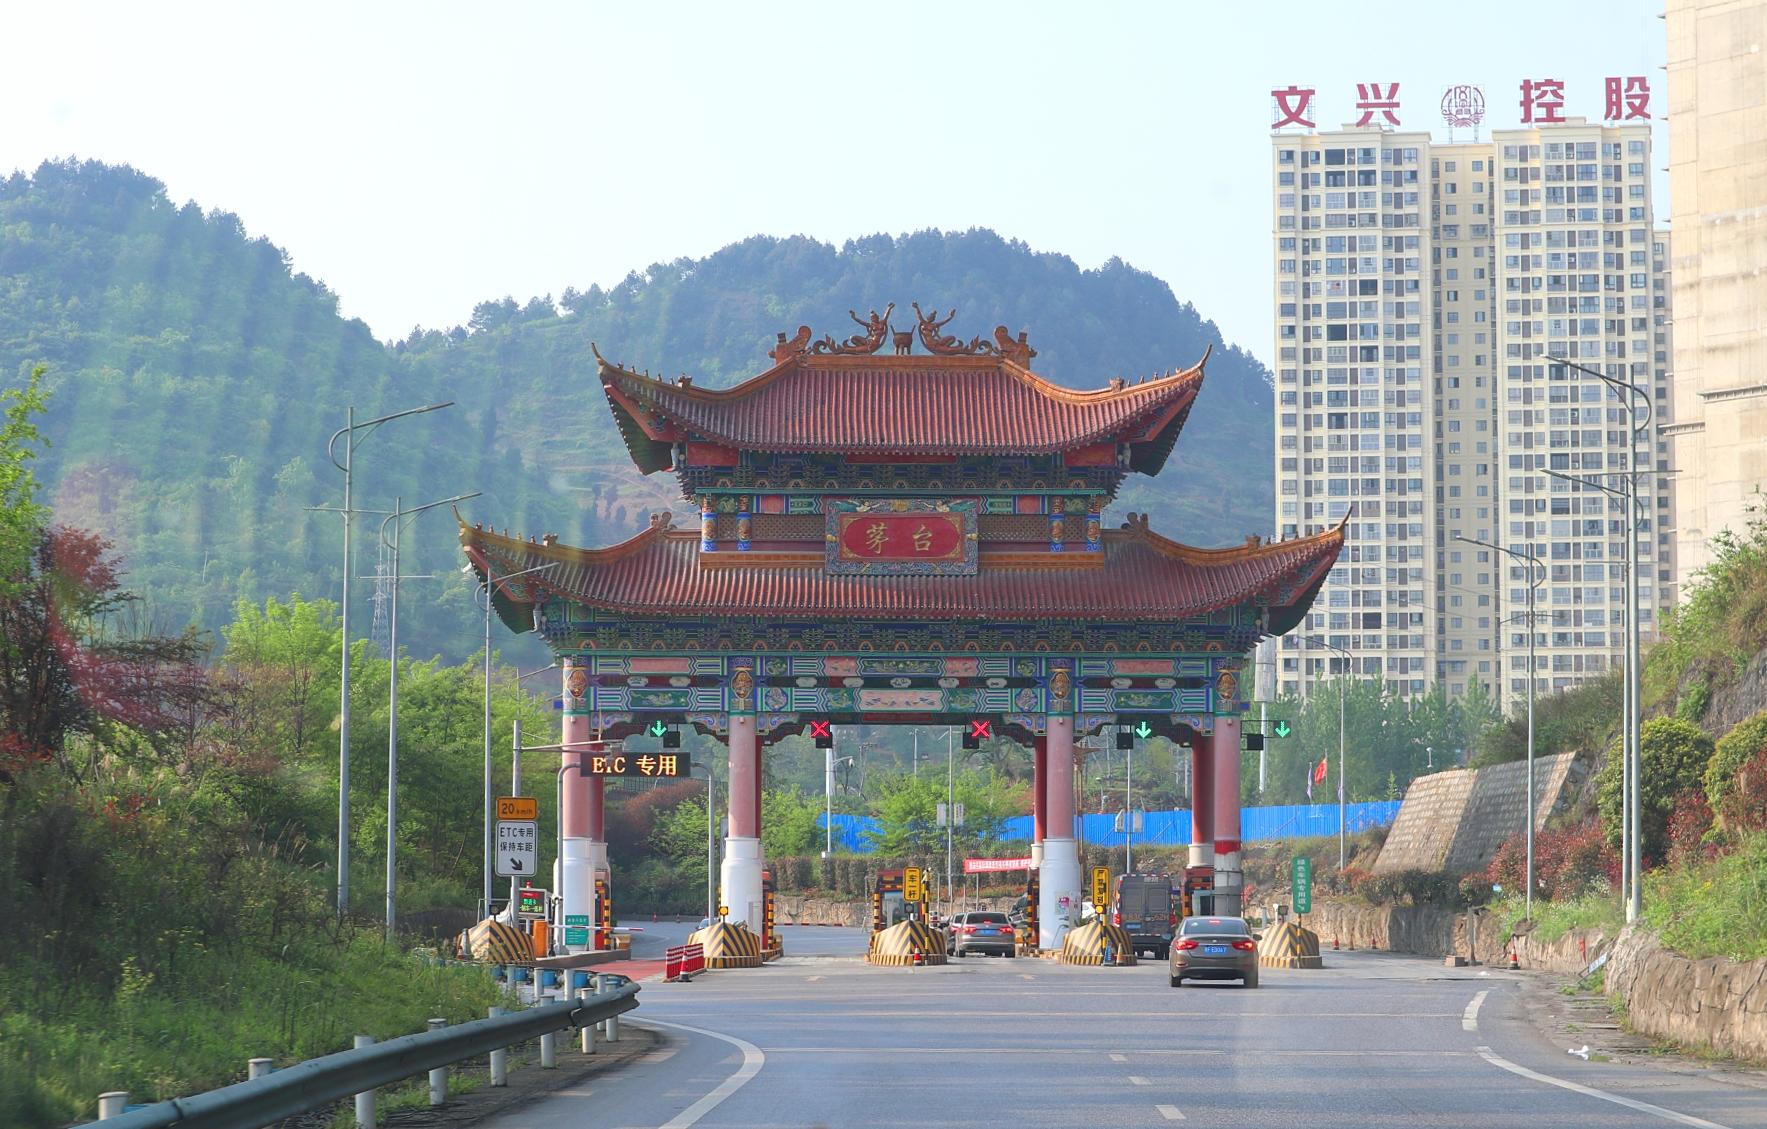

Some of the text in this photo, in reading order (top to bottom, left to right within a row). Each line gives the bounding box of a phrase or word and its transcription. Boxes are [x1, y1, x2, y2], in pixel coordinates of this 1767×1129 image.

[1271, 76, 1652, 129] 文兴 控股
[865, 521, 933, 554] 茅台
[635, 754, 678, 776] 专用
[501, 803, 514, 815] 20
[500, 826, 534, 838] ETC专用
[500, 841, 534, 853] 保持车距
